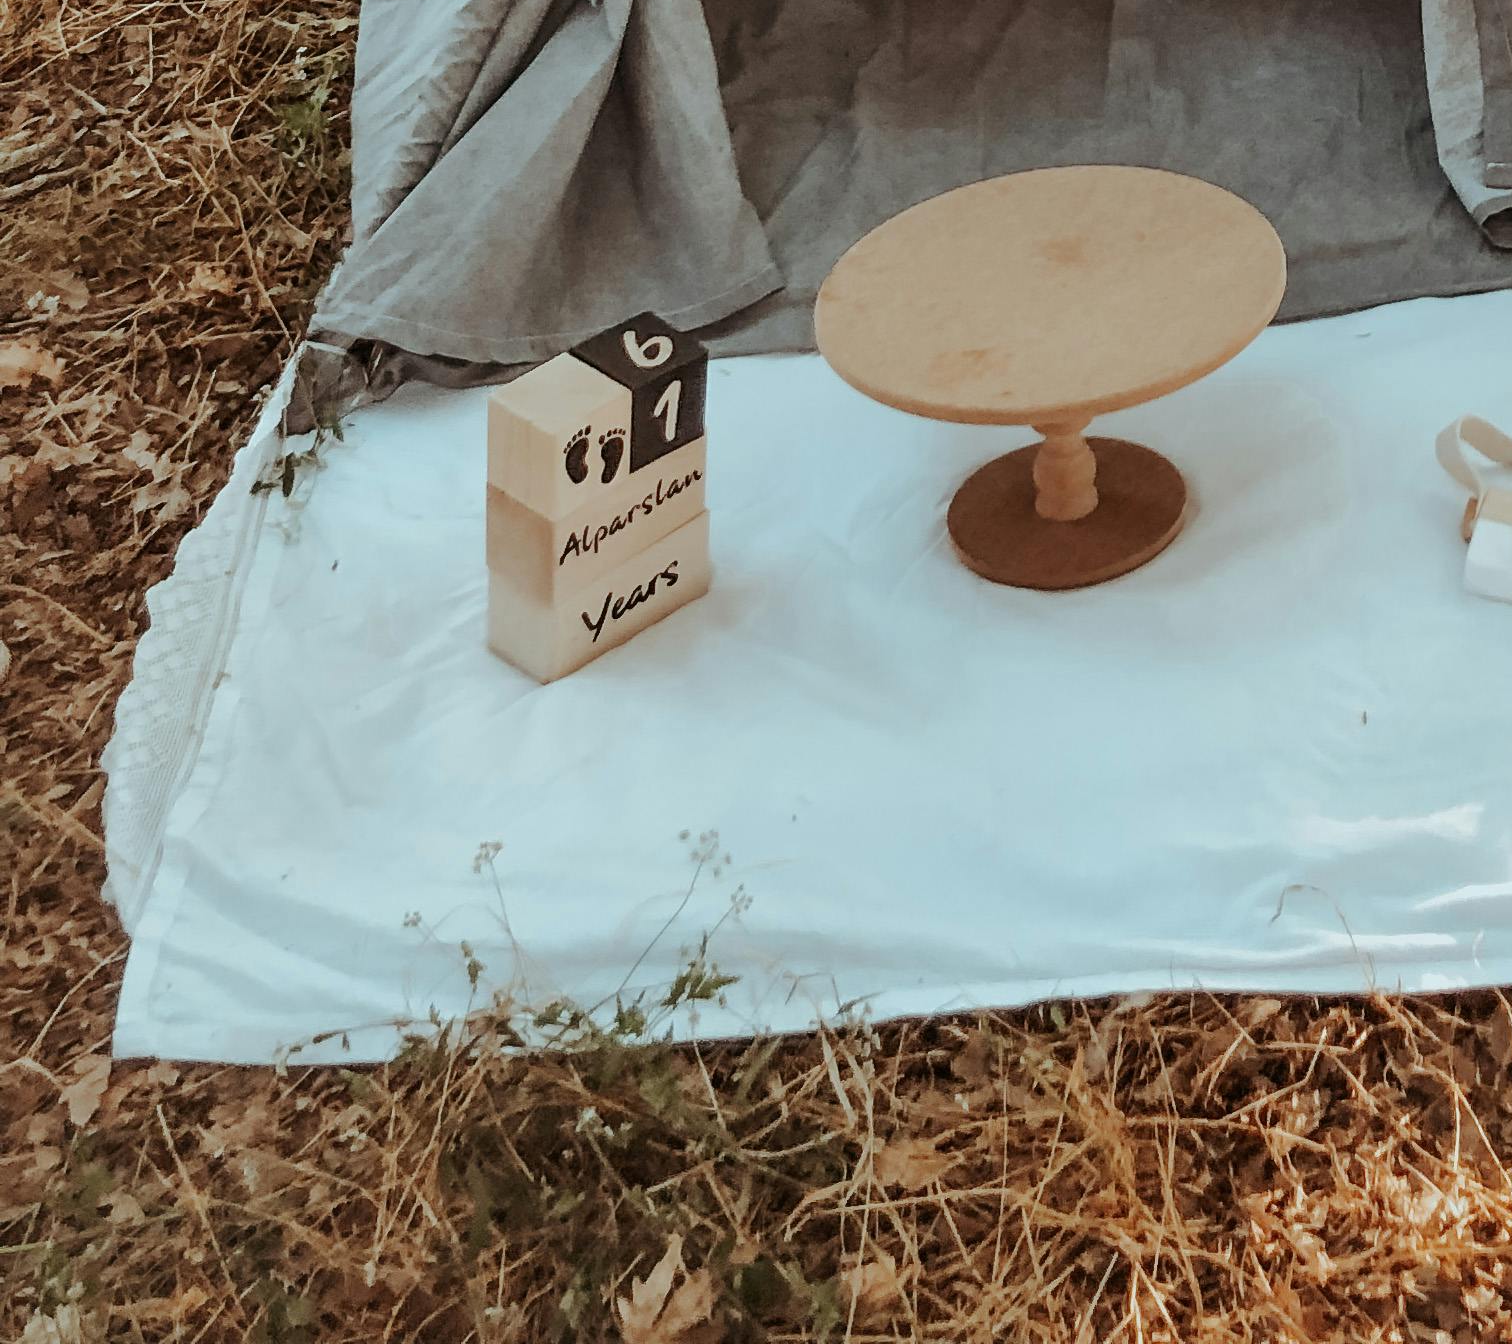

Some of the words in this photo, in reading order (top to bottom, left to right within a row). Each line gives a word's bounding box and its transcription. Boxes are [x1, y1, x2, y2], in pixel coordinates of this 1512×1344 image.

[622, 330, 674, 369] 6
[653, 379, 682, 442] 1
[558, 467, 704, 566] Alparslan
[580, 559, 680, 643] Years
